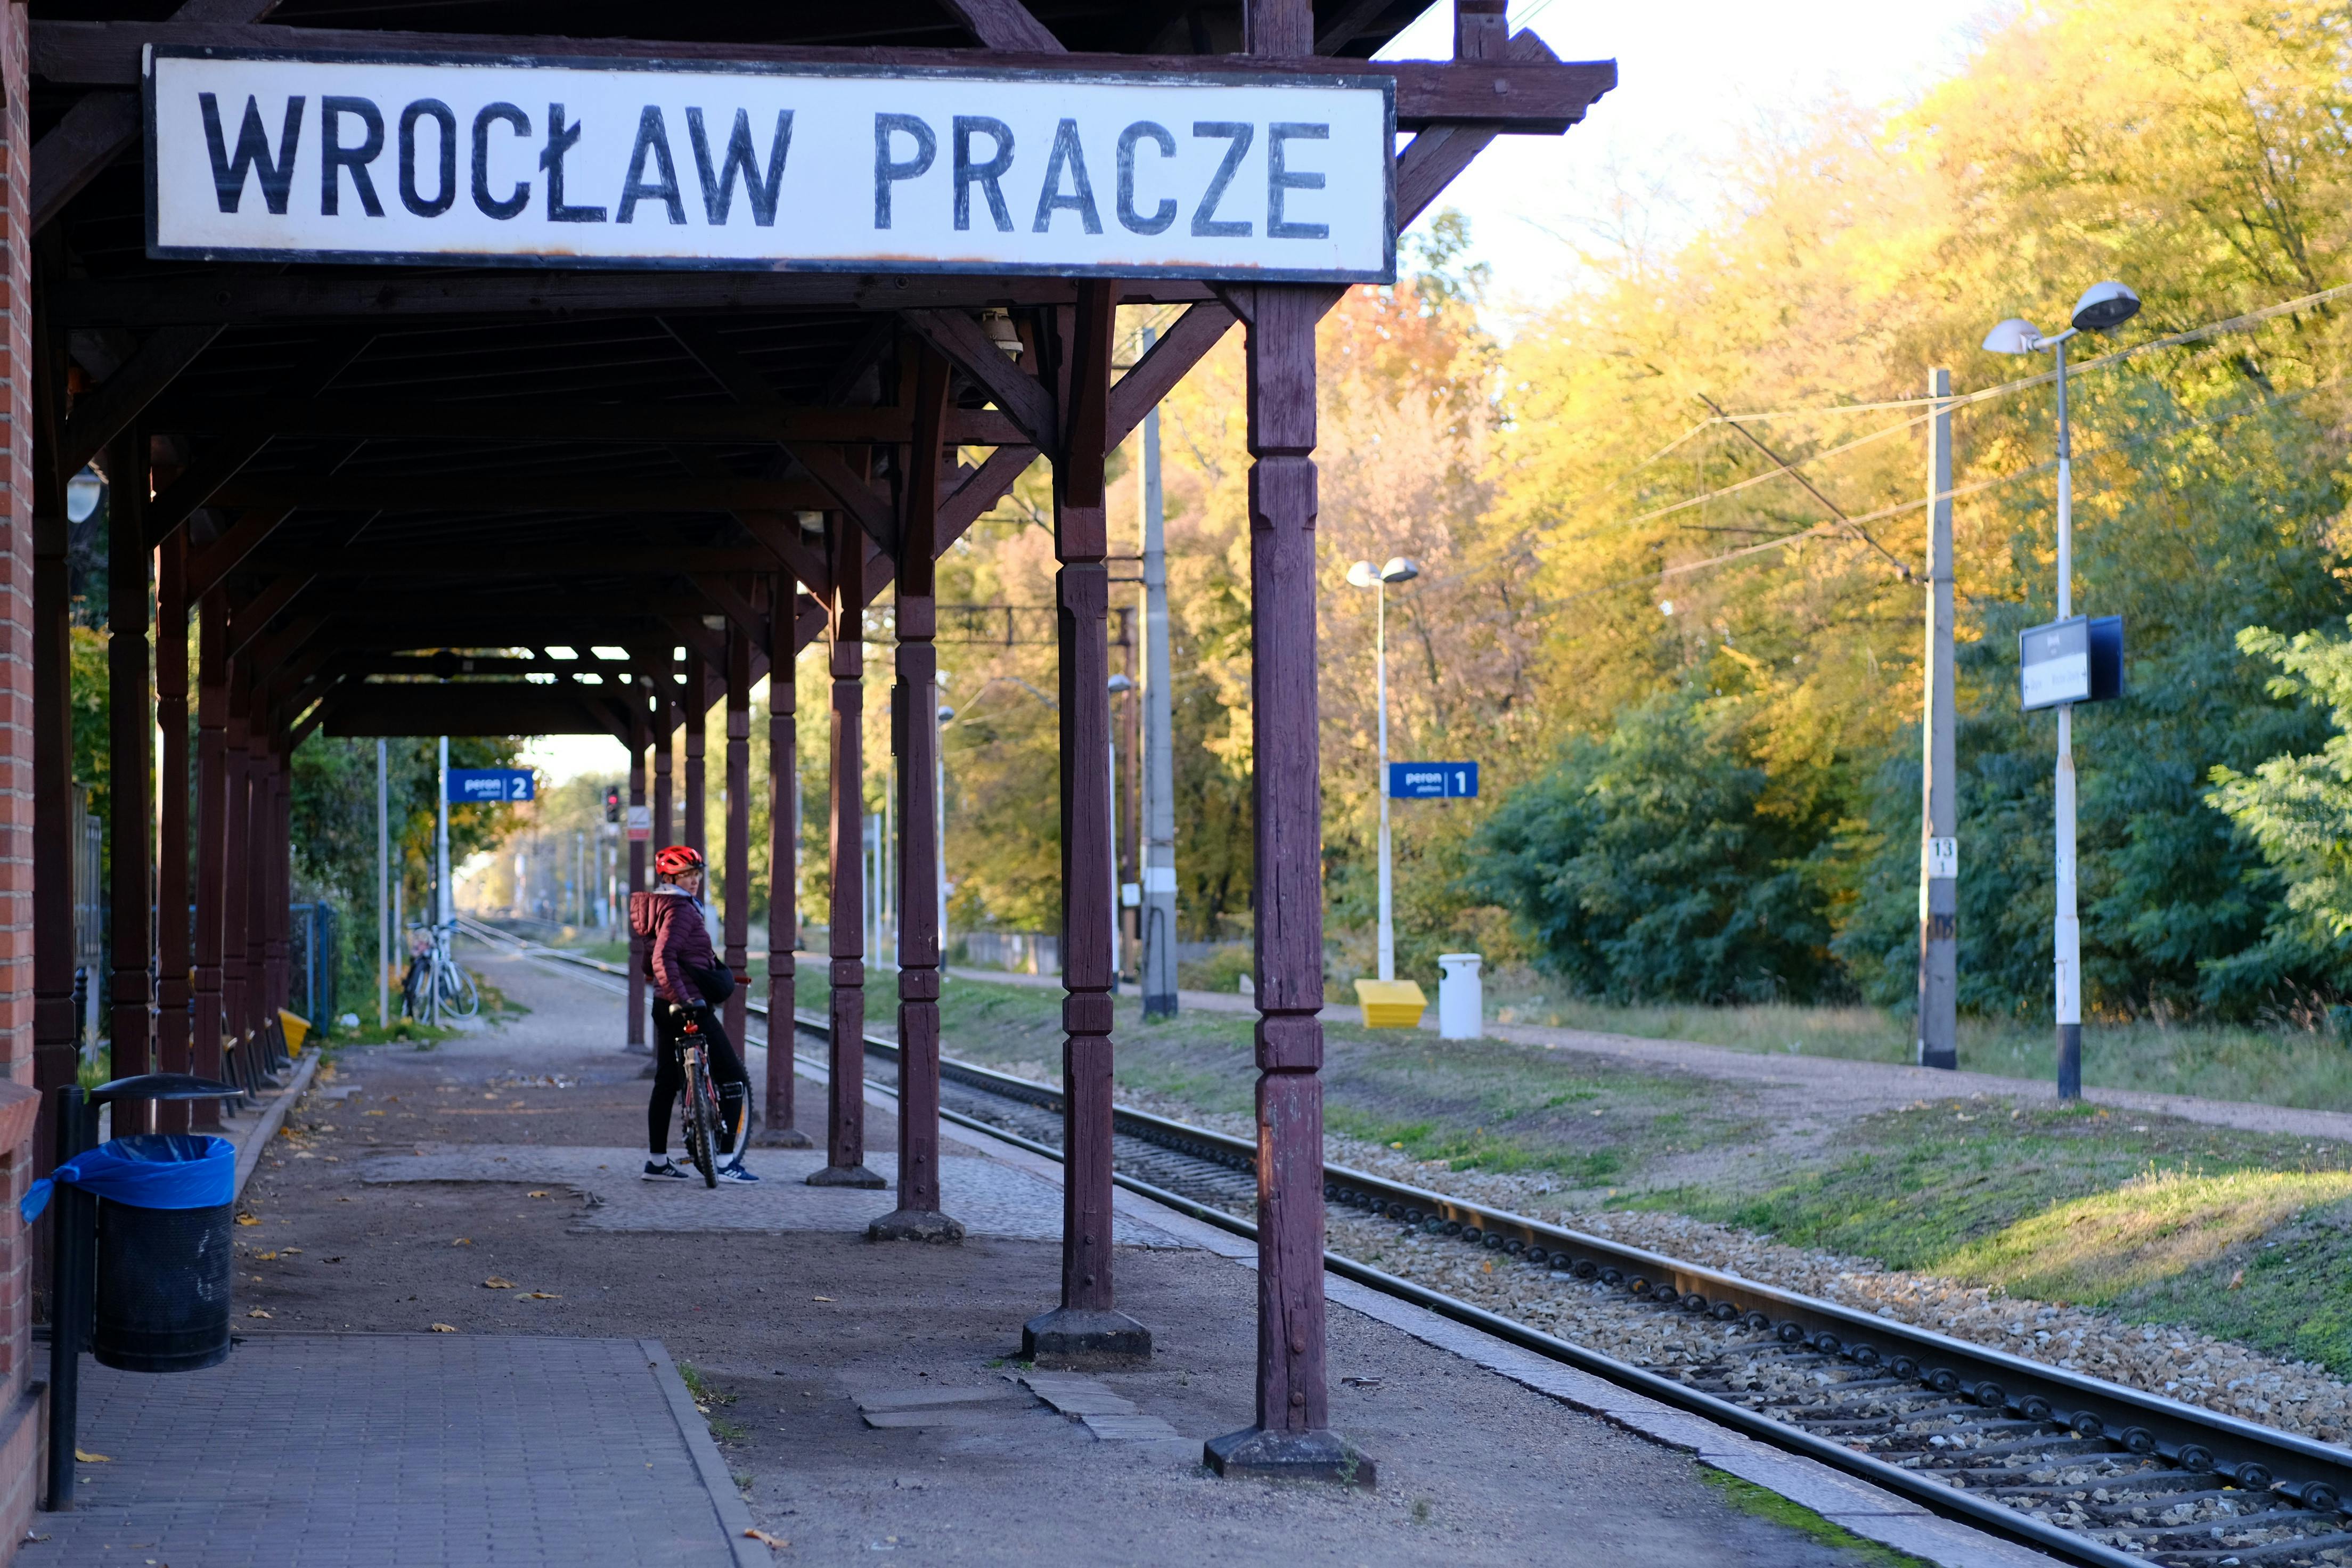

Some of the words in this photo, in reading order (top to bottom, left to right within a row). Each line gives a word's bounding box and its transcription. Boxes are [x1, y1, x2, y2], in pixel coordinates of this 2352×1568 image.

[198, 92, 793, 226] WROCŁAW
[874, 112, 1330, 239] PRACZE
[512, 777, 527, 798] 2
[1406, 773, 1442, 786] peron
[1455, 771, 1466, 794] 1
[1935, 839, 1953, 857] 13
